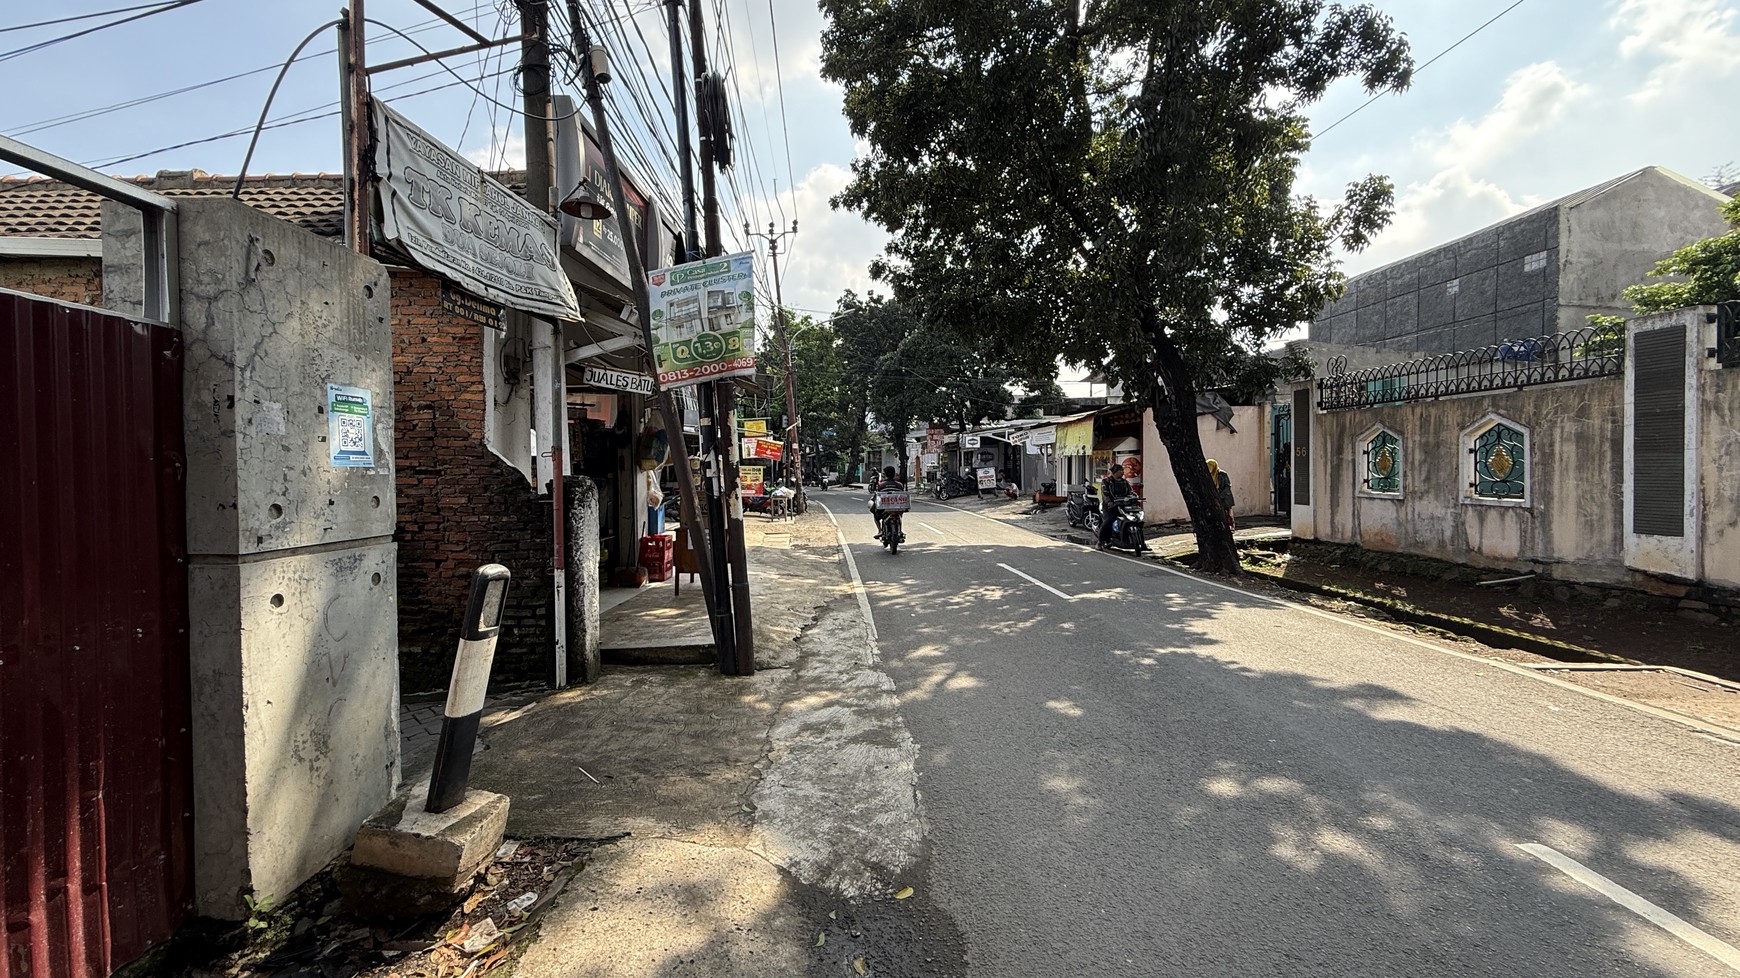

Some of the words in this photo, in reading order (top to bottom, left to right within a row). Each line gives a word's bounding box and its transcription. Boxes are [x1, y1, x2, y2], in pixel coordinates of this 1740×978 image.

[407, 132, 460, 178] YAYASAN
[404, 166, 456, 225] TK
[441, 222, 478, 260] DUA
[479, 243, 535, 281] SEJOLI
[719, 262, 729, 273] 2
[660, 283, 702, 299] PRIVATE
[702, 272, 747, 288] CLUSTER
[630, 377, 654, 392] BATU
[1296, 446, 1307, 457] 56
